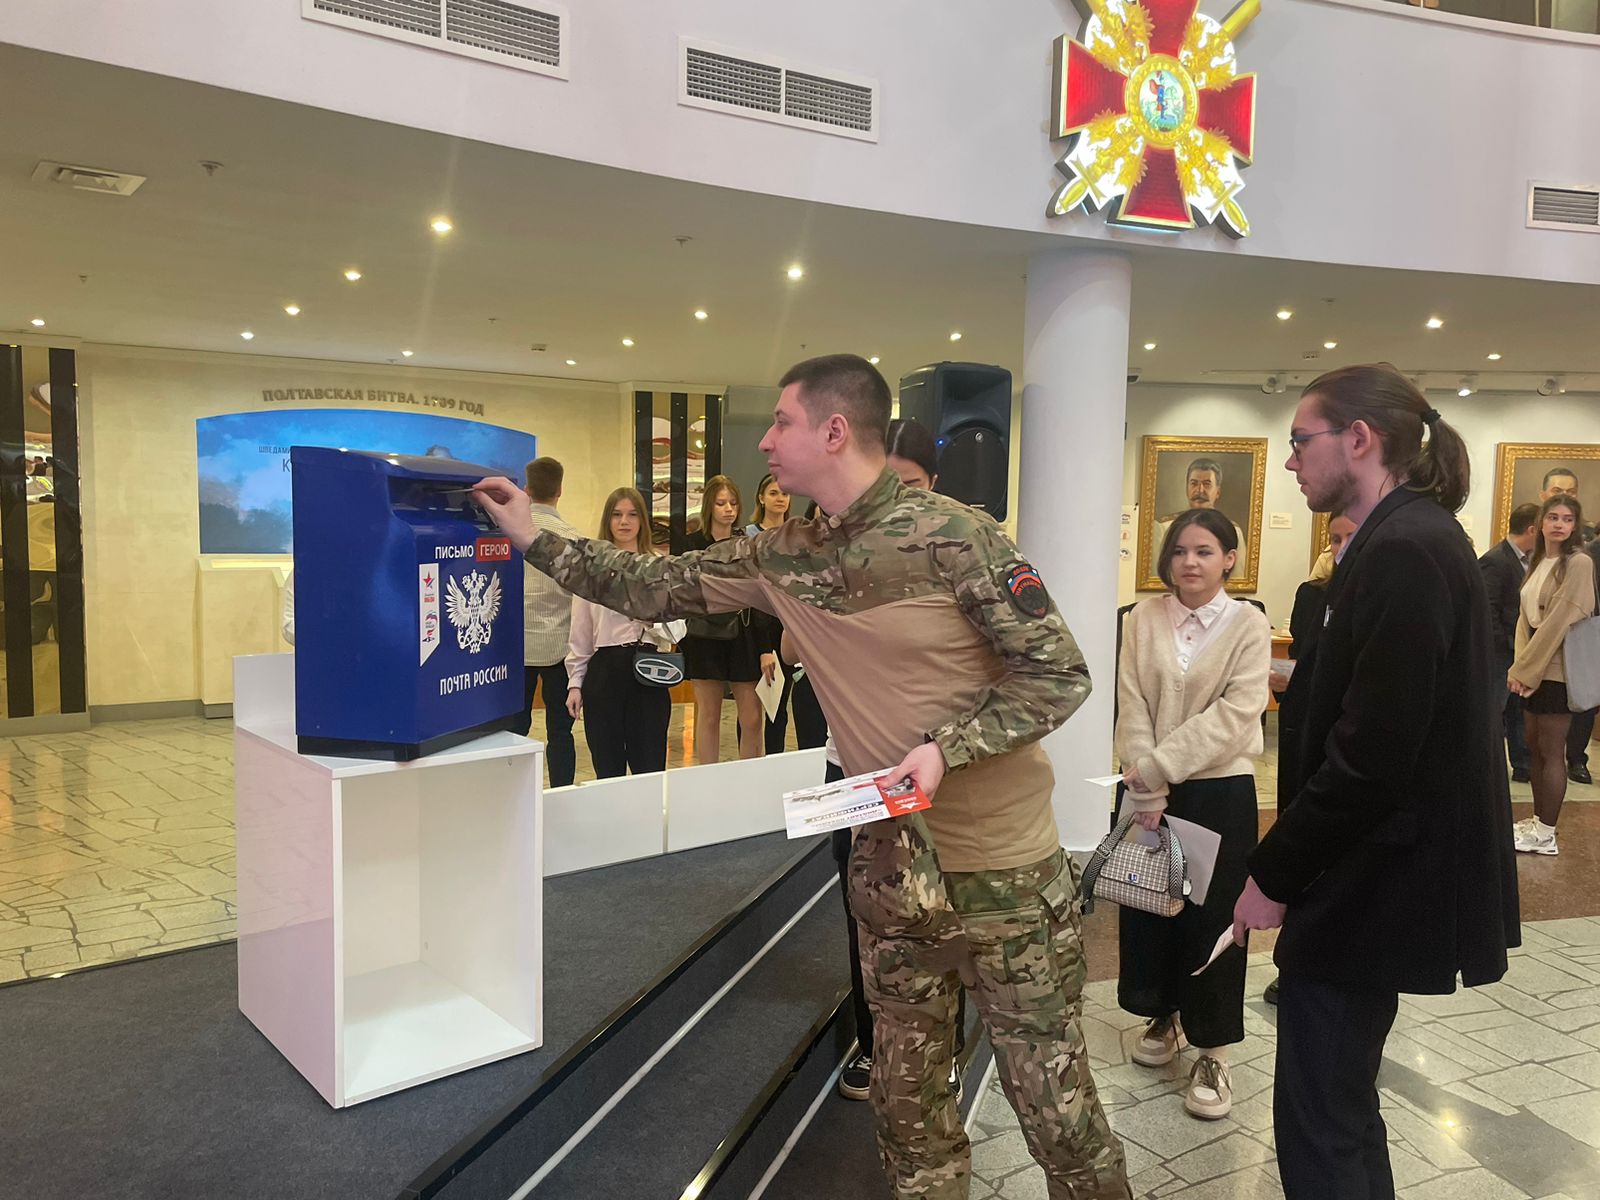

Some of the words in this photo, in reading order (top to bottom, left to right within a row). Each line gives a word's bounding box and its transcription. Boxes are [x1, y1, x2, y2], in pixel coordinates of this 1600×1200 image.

[263, 389, 363, 401] ПОЛТАВСКАЯ
[367, 390, 419, 405] БИТВА.
[458, 400, 485, 417] ГОД
[435, 546, 474, 559] ПИСЬМО
[480, 544, 509, 556] ГЕРОЮ
[440, 673, 471, 695] ПОЧТА
[474, 664, 508, 687] РОССИИ
